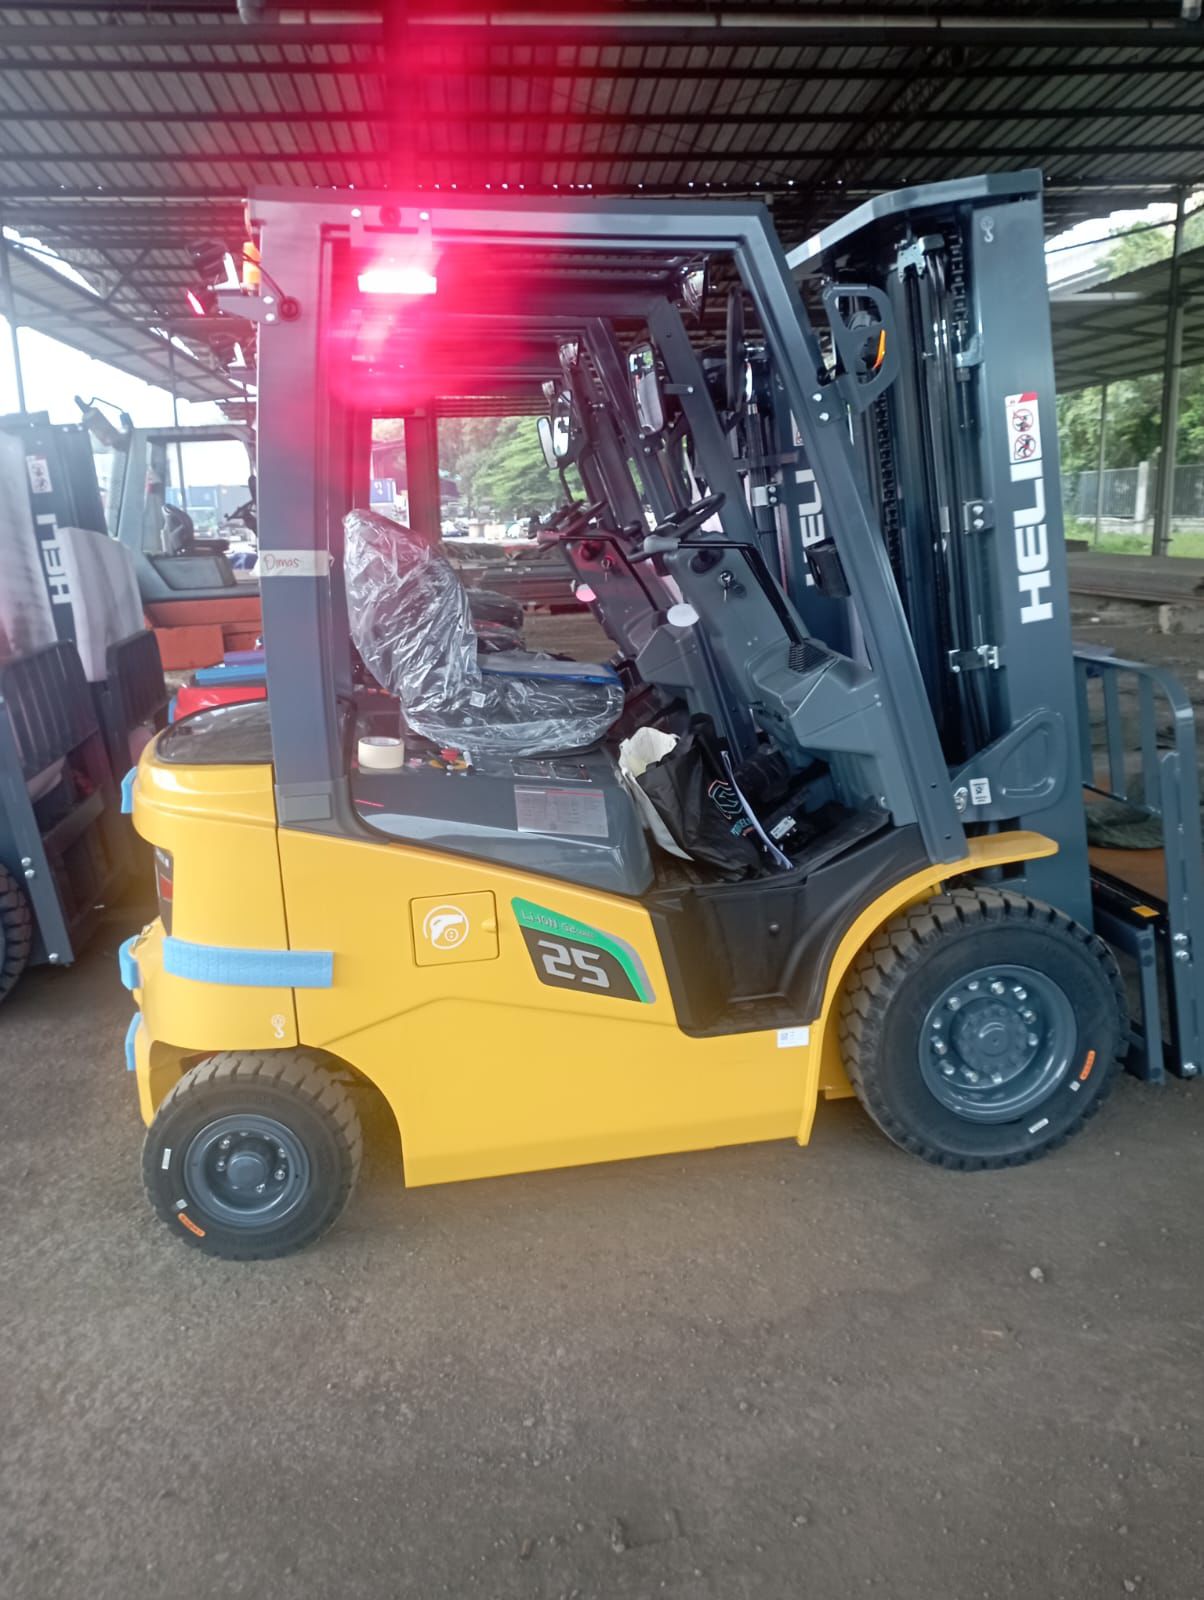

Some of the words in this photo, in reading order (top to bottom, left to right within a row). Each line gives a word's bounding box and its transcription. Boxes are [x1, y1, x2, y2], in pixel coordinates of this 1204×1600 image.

[795, 468, 826, 587] ELI
[1009, 458, 1054, 624] HELI
[537, 939, 610, 989] 25
